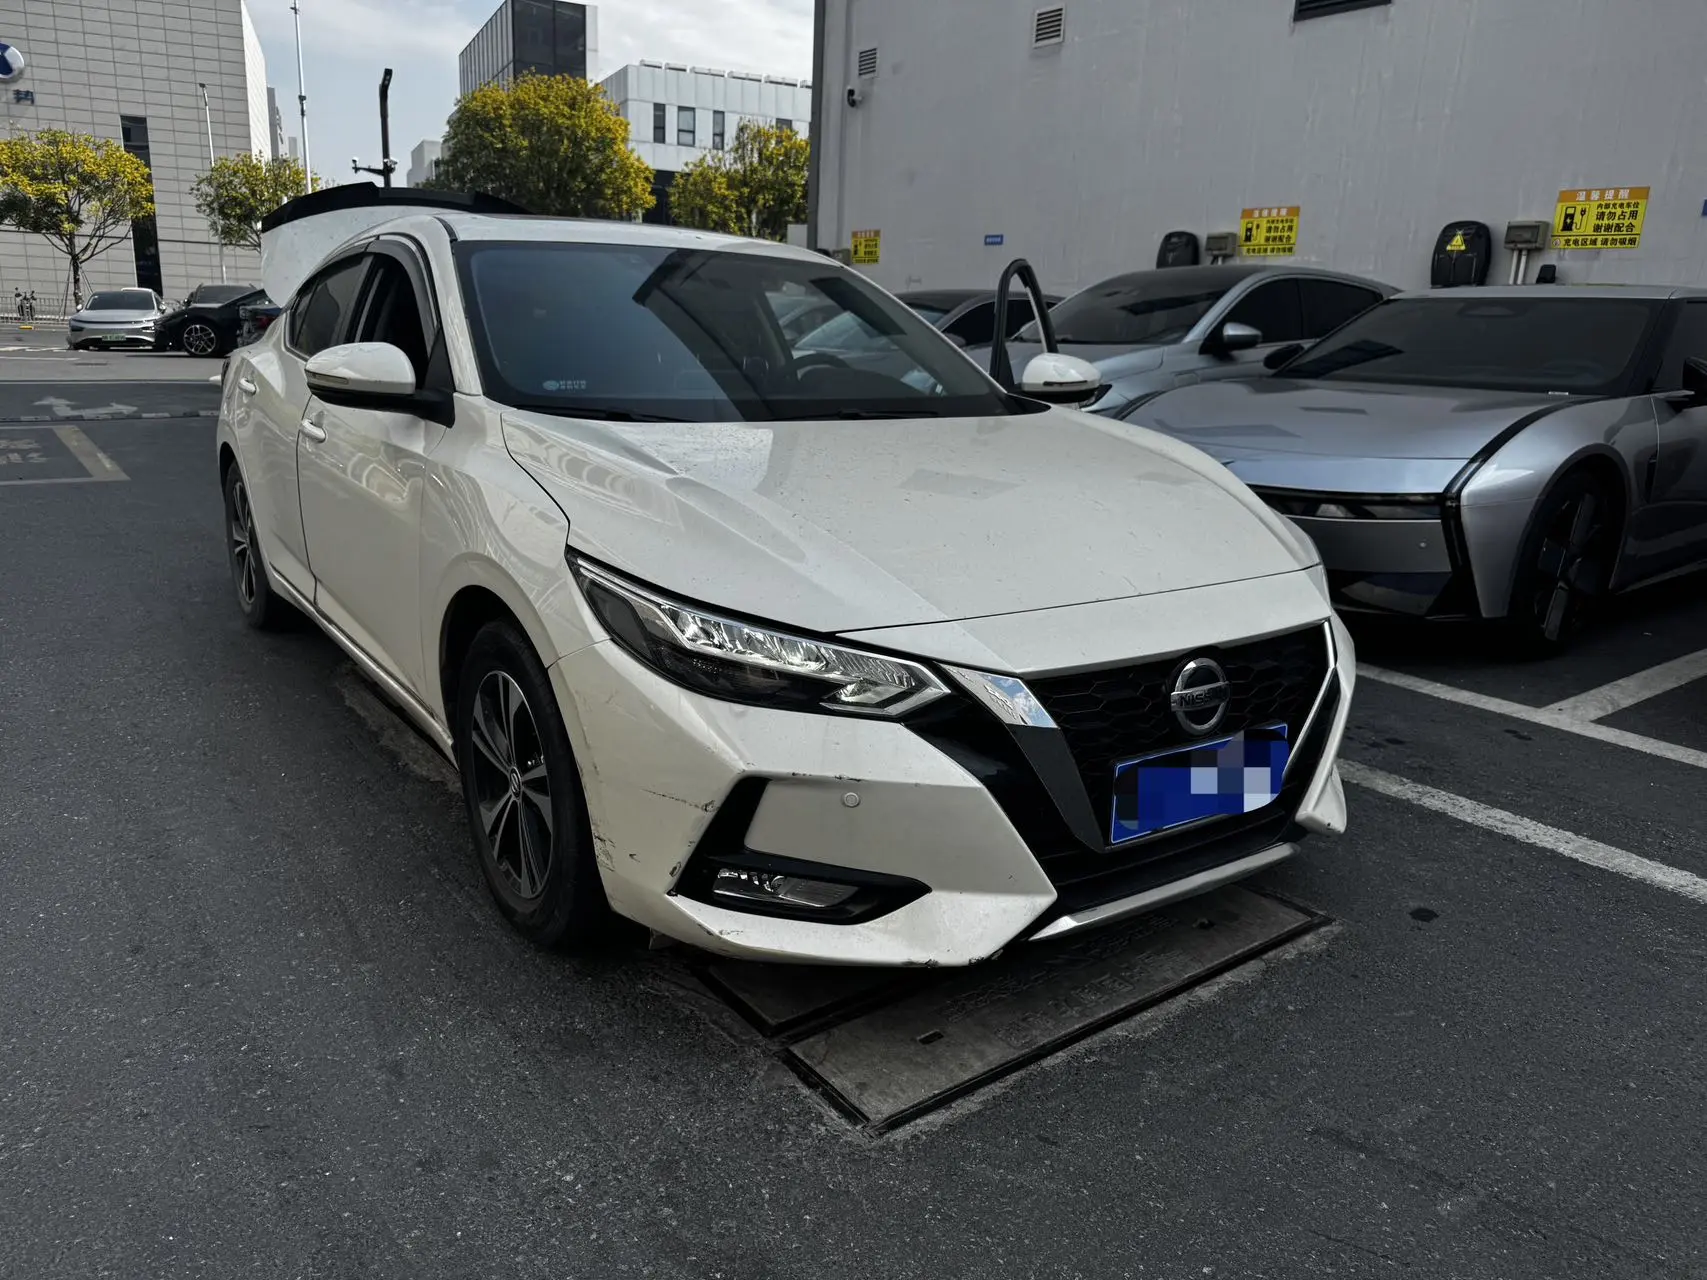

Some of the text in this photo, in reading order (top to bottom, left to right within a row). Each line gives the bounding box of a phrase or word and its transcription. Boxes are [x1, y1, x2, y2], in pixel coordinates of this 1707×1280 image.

[1596, 210, 1638, 221] 请勿占用
[1593, 222, 1635, 233] 谢谢配合
